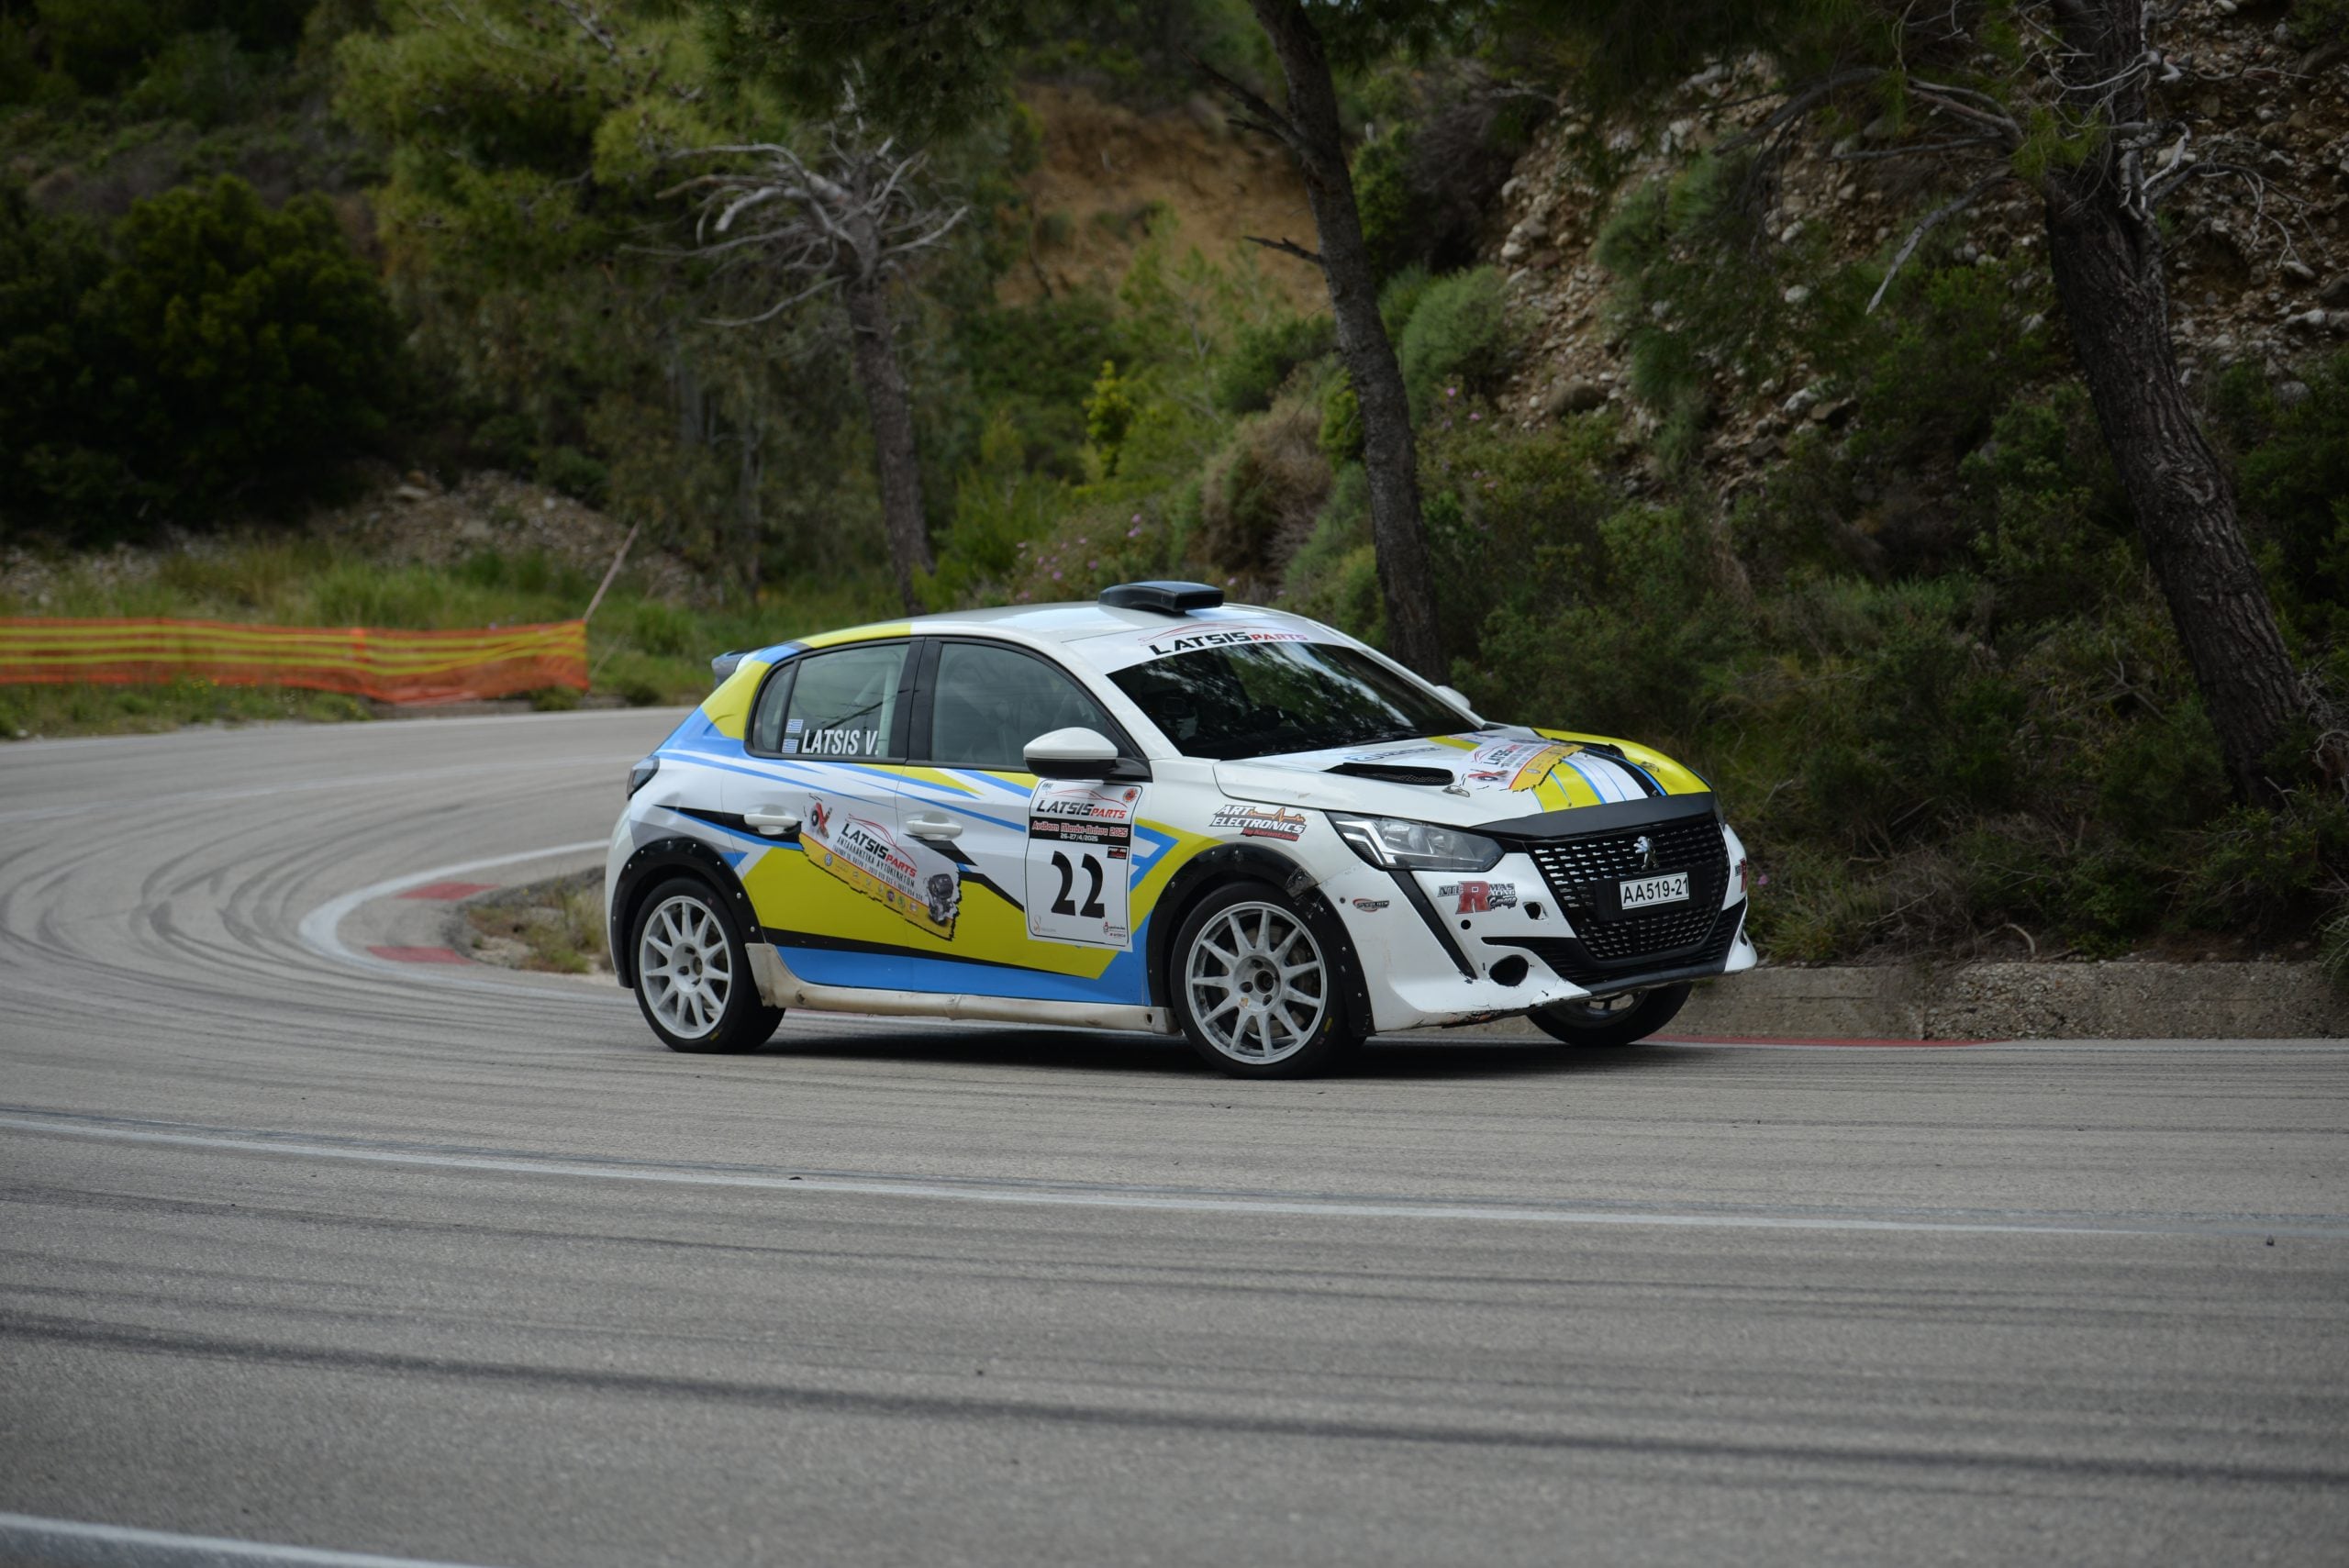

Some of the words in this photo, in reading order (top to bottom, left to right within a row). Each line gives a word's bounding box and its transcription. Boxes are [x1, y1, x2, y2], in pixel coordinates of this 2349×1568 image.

[801, 729, 860, 755] LATSIS
[865, 730, 879, 755] V.
[1217, 805, 1253, 816] ART
[1108, 826, 1129, 838] 2025
[1211, 817, 1307, 835] ELECTRONICS
[1051, 851, 1105, 919] 22
[1623, 878, 1688, 904] AA519-21
